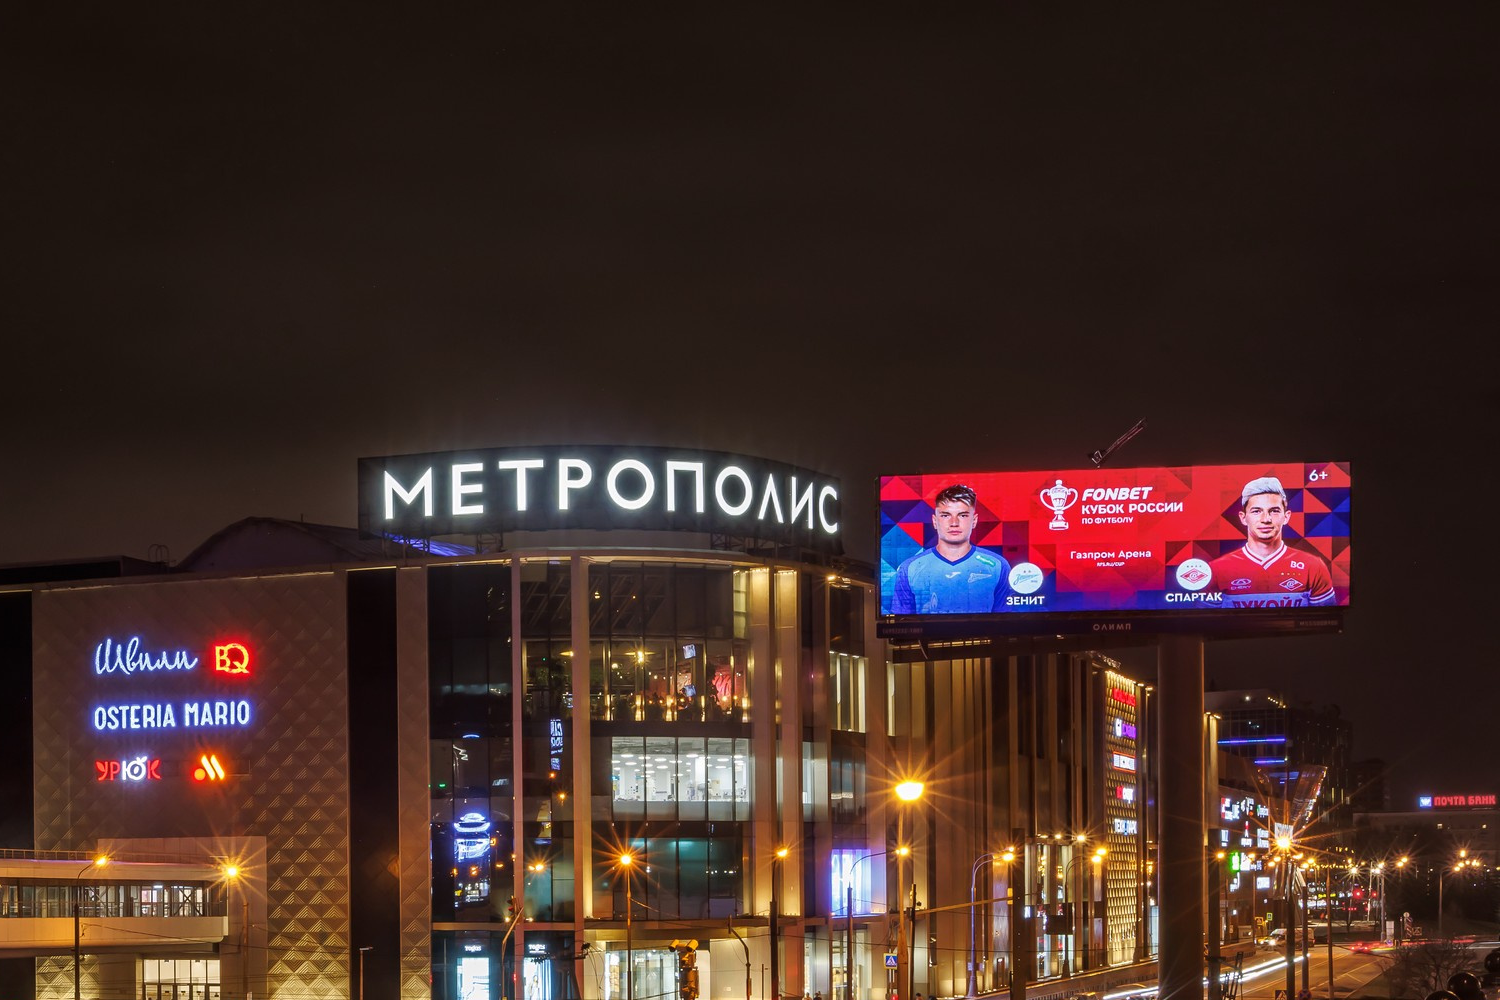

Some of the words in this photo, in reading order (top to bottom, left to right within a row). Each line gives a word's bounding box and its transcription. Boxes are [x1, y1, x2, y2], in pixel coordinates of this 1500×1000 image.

[1309, 469, 1328, 482] 6+
[384, 458, 840, 535] МЕТРОПОЛИС
[1081, 486, 1153, 501] FONBET
[1081, 503, 1124, 515] КУБОК
[1128, 502, 1183, 514] РОССИИ
[1081, 517, 1093, 525] ПО
[1094, 516, 1133, 525] ФУТБОЛУ
[1070, 550, 1115, 560] Газпром
[1118, 550, 1152, 560] Арена
[1006, 595, 1045, 606] ЗЕНИТ
[1165, 592, 1223, 602] СПАРТАК
[1092, 623, 1131, 631] ОЛИМП
[94, 636, 199, 676] Швили
[94, 704, 176, 731] OSTERIA
[185, 700, 250, 727] MARIO
[95, 755, 162, 781] УРЮК
[1433, 796, 1466, 806] ПОЧТА
[1468, 795, 1496, 806] БАНК
